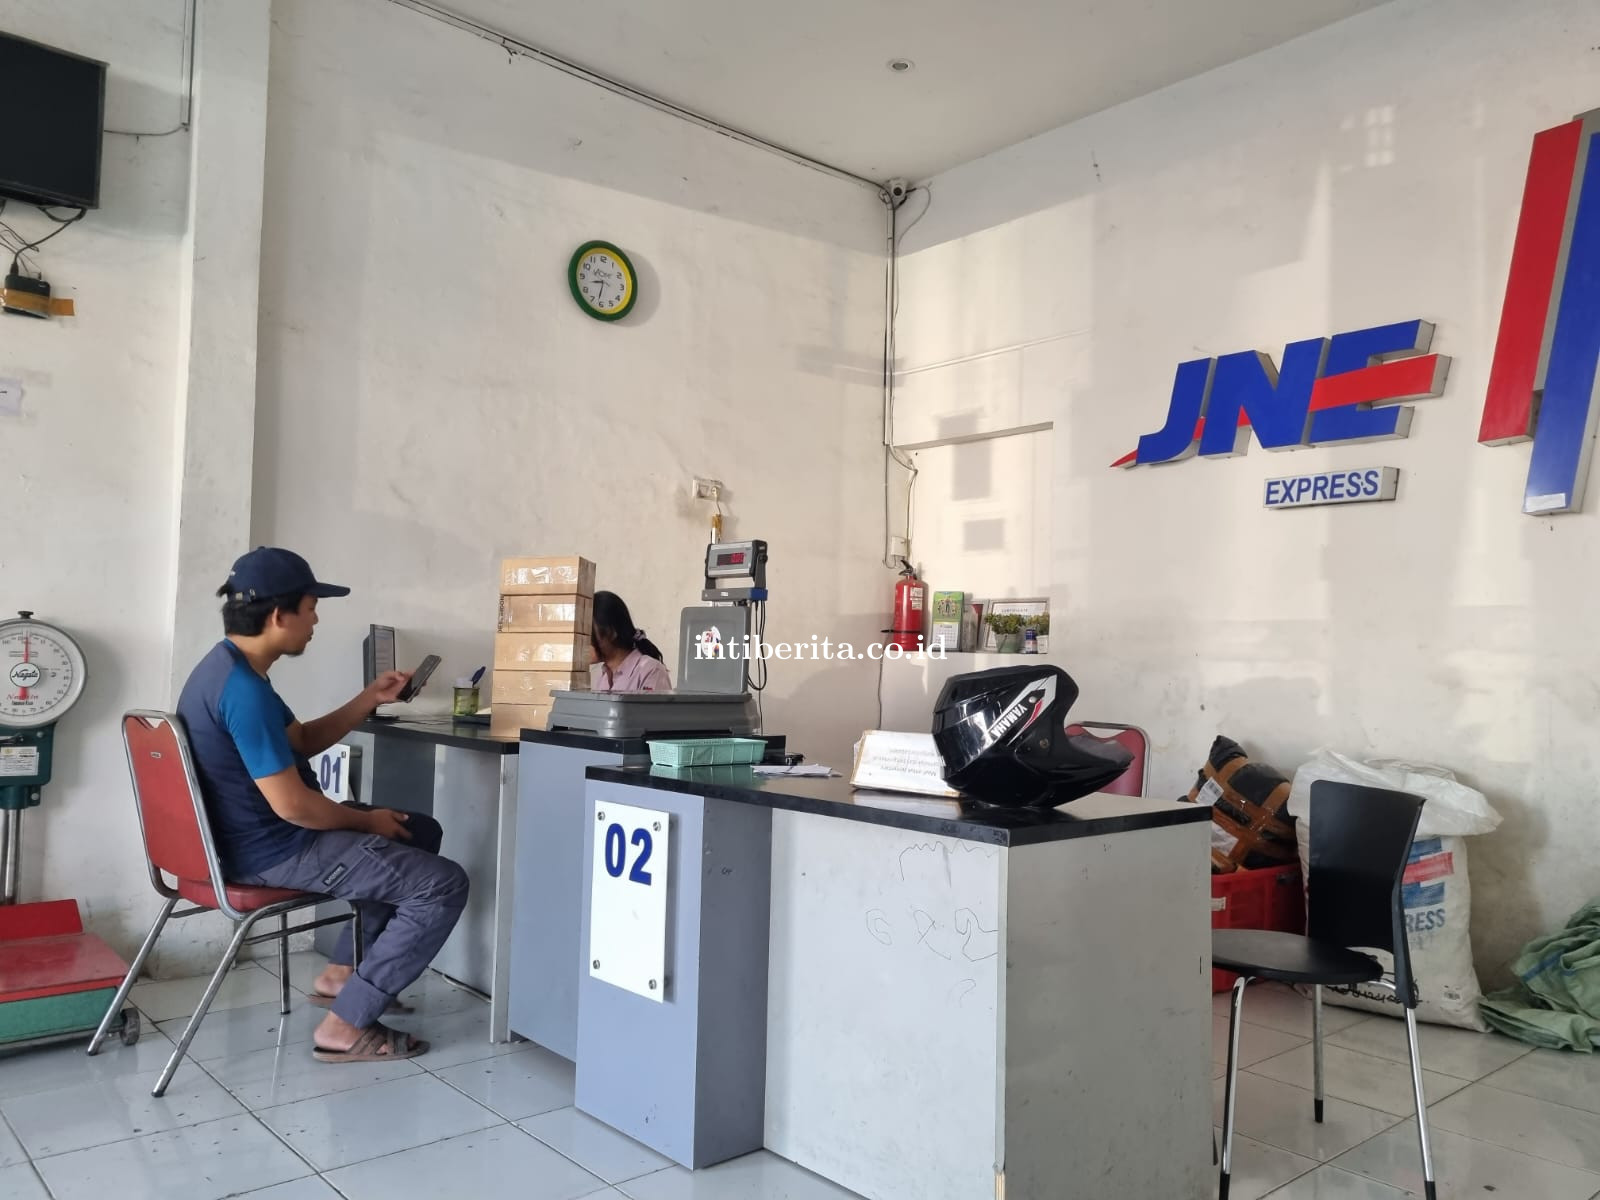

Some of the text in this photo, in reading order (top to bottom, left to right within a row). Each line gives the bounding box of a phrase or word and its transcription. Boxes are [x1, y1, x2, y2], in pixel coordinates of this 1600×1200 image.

[1110, 318, 1442, 467] JNE
[1265, 470, 1379, 505] EXPRESS
[990, 703, 1028, 738] YAMAHA
[321, 754, 341, 794] 01
[605, 822, 653, 886] 02
